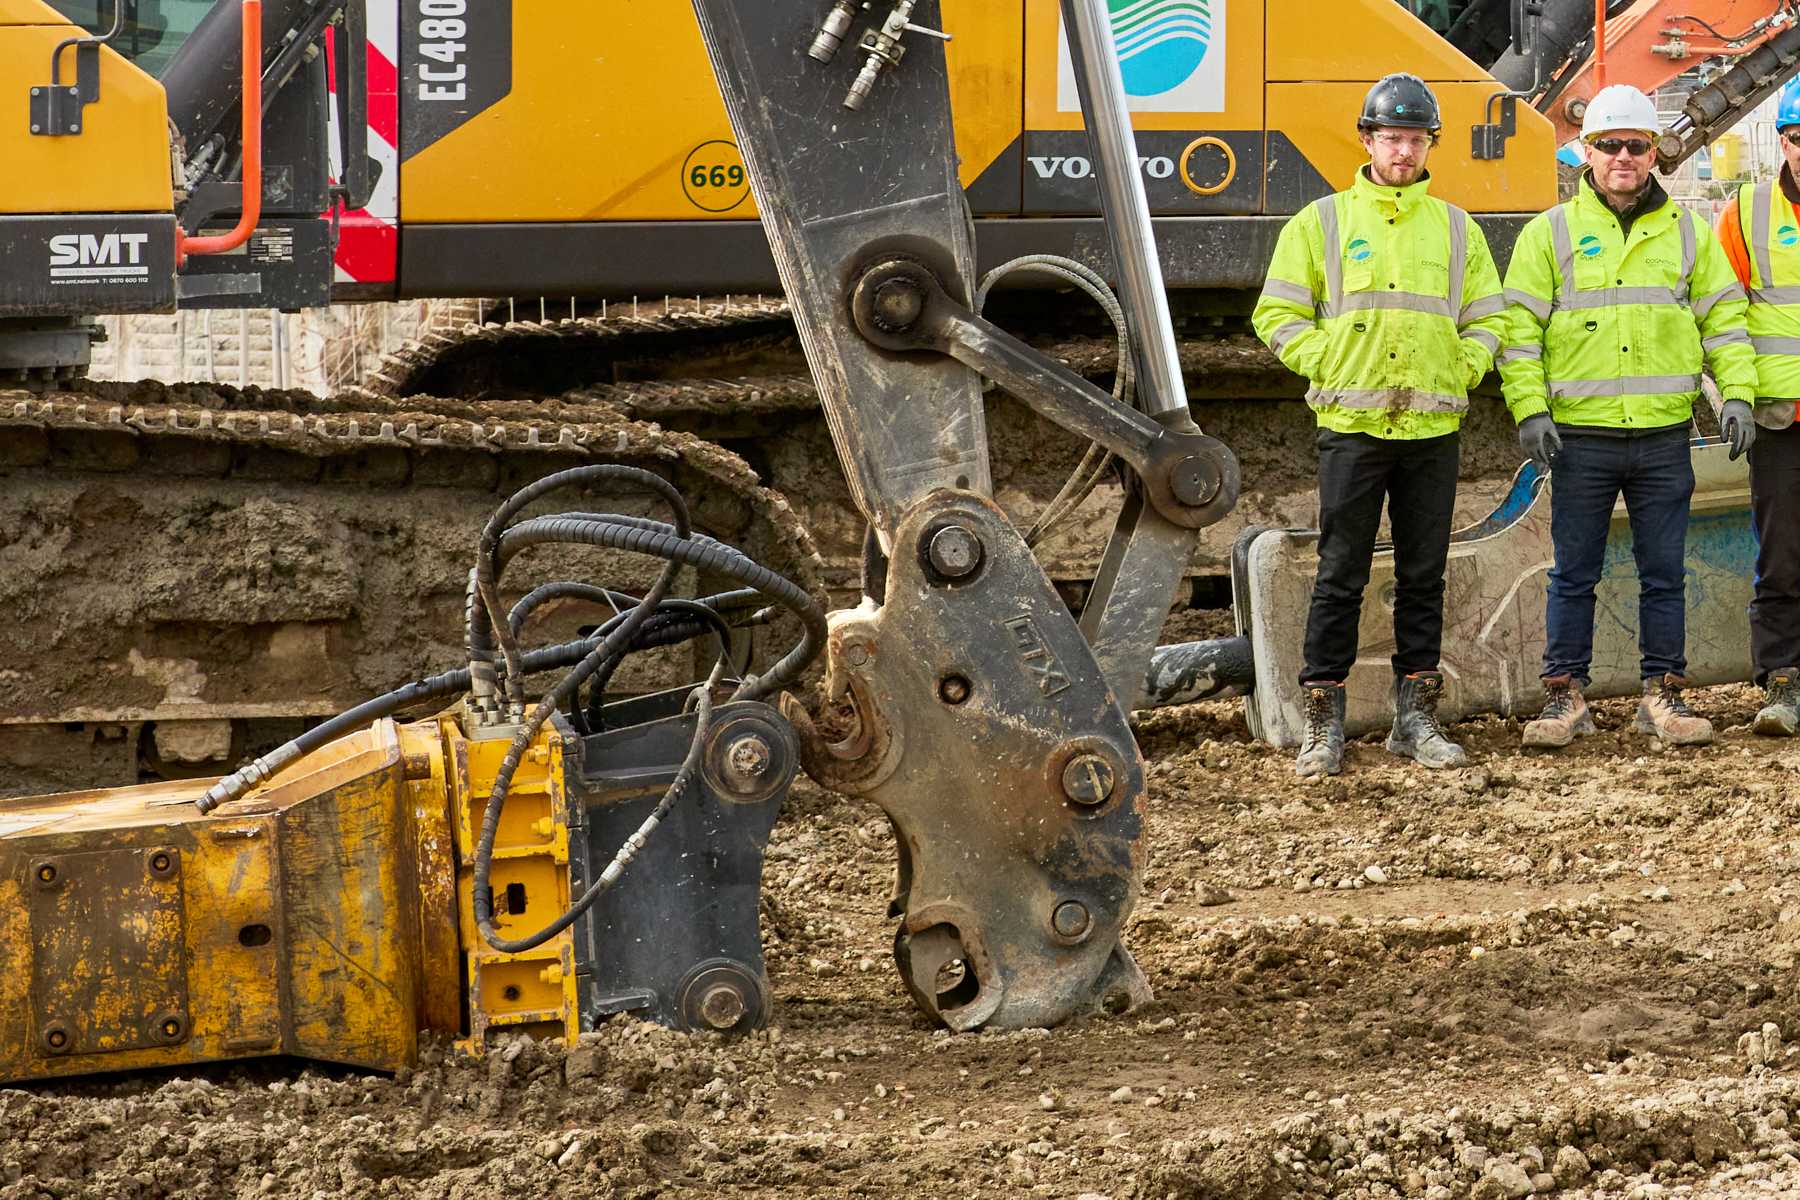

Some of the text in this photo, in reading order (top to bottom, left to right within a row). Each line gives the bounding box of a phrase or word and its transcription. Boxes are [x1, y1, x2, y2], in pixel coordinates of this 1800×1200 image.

[691, 164, 744, 188] 669
[1027, 156, 1174, 178] VOO
[49, 233, 148, 265] SMT
